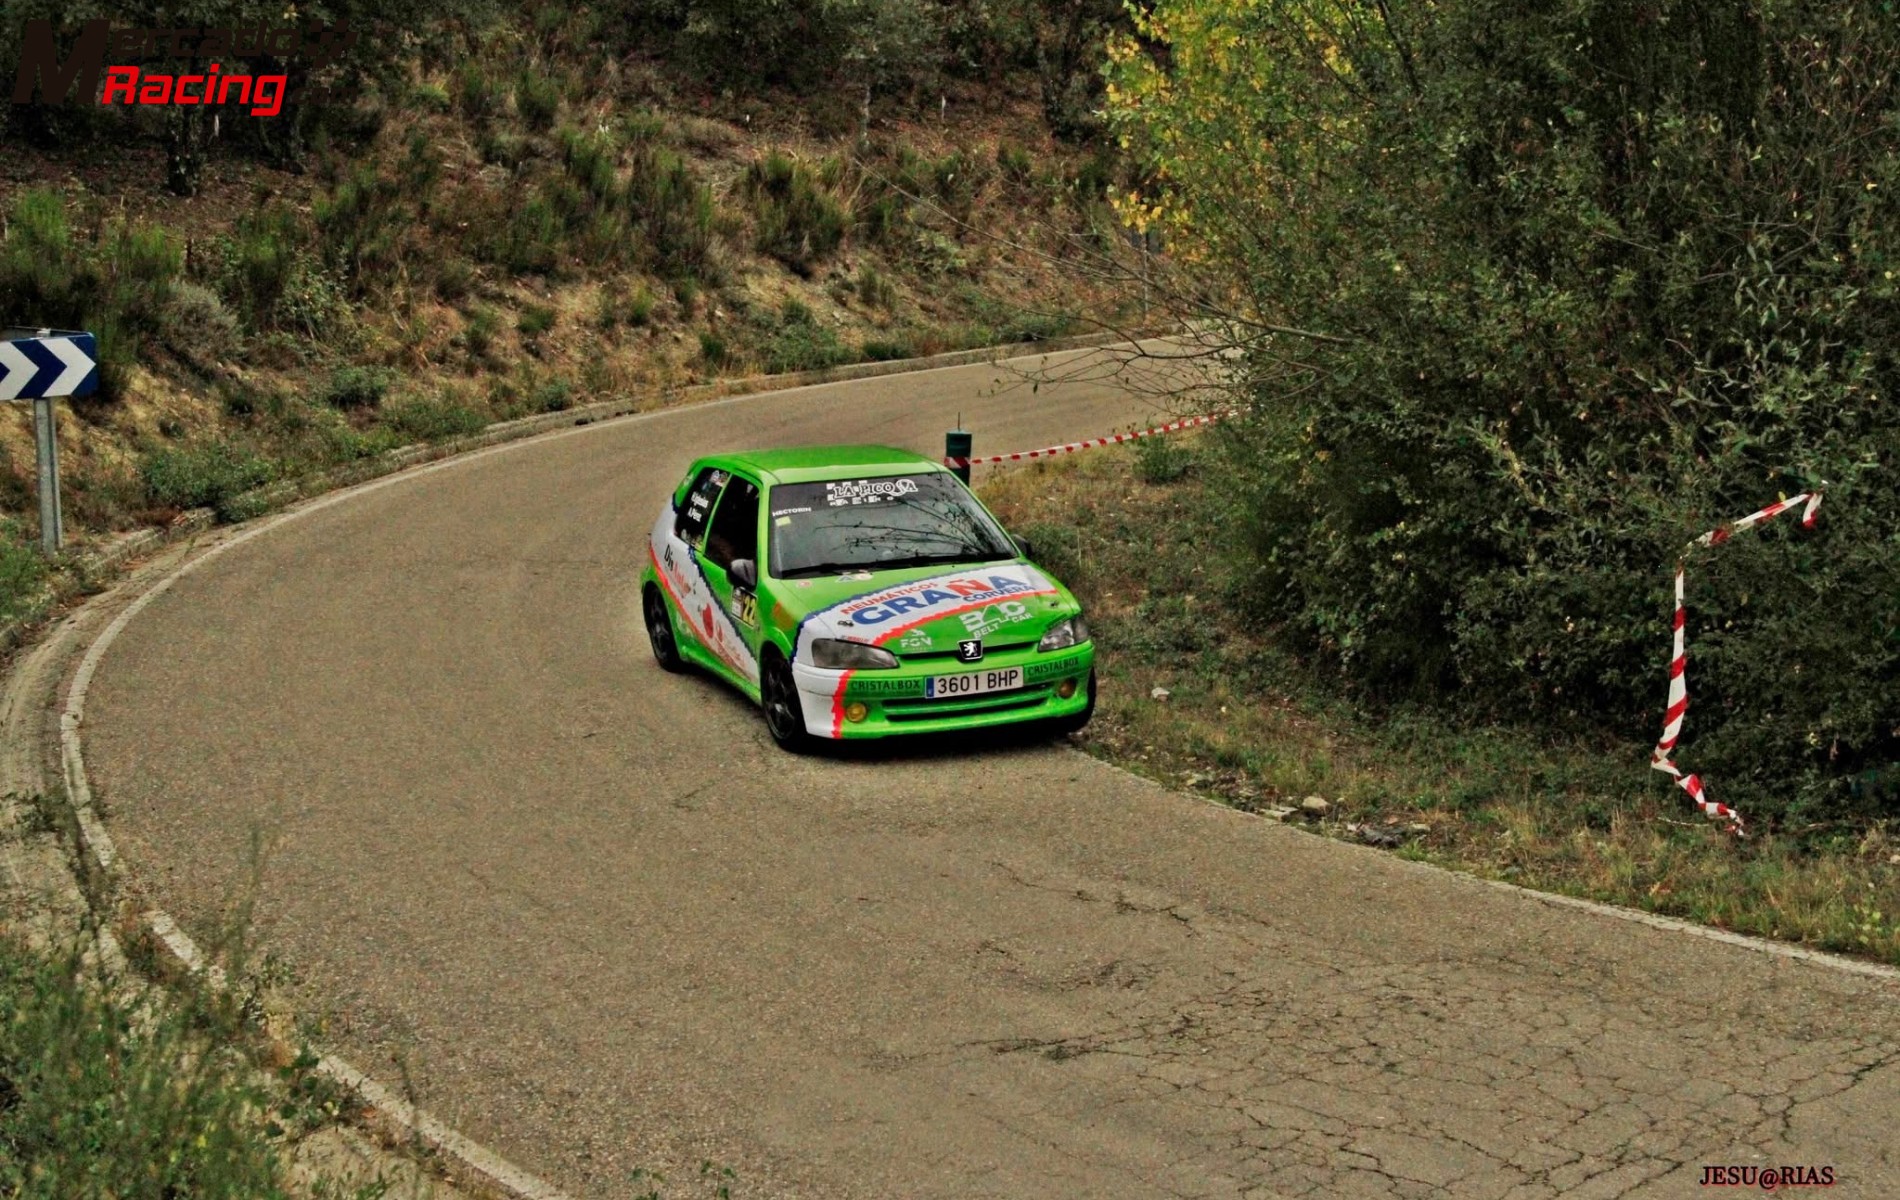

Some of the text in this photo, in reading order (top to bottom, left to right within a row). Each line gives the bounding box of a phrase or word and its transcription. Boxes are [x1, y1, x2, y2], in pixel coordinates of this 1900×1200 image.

[834, 479, 918, 498] LA PICOSA
[772, 507, 812, 517] HECTORIN
[841, 583, 938, 615] NEUMÁTICOS
[852, 575, 1026, 625] GRAÑA
[963, 585, 1036, 602] CORVERA
[973, 613, 1033, 639] BELT CAR
[1027, 656, 1079, 675] CRISTALBOX
[851, 680, 921, 691] CRISTALBOX
[938, 670, 1018, 694] 3601 BHP
